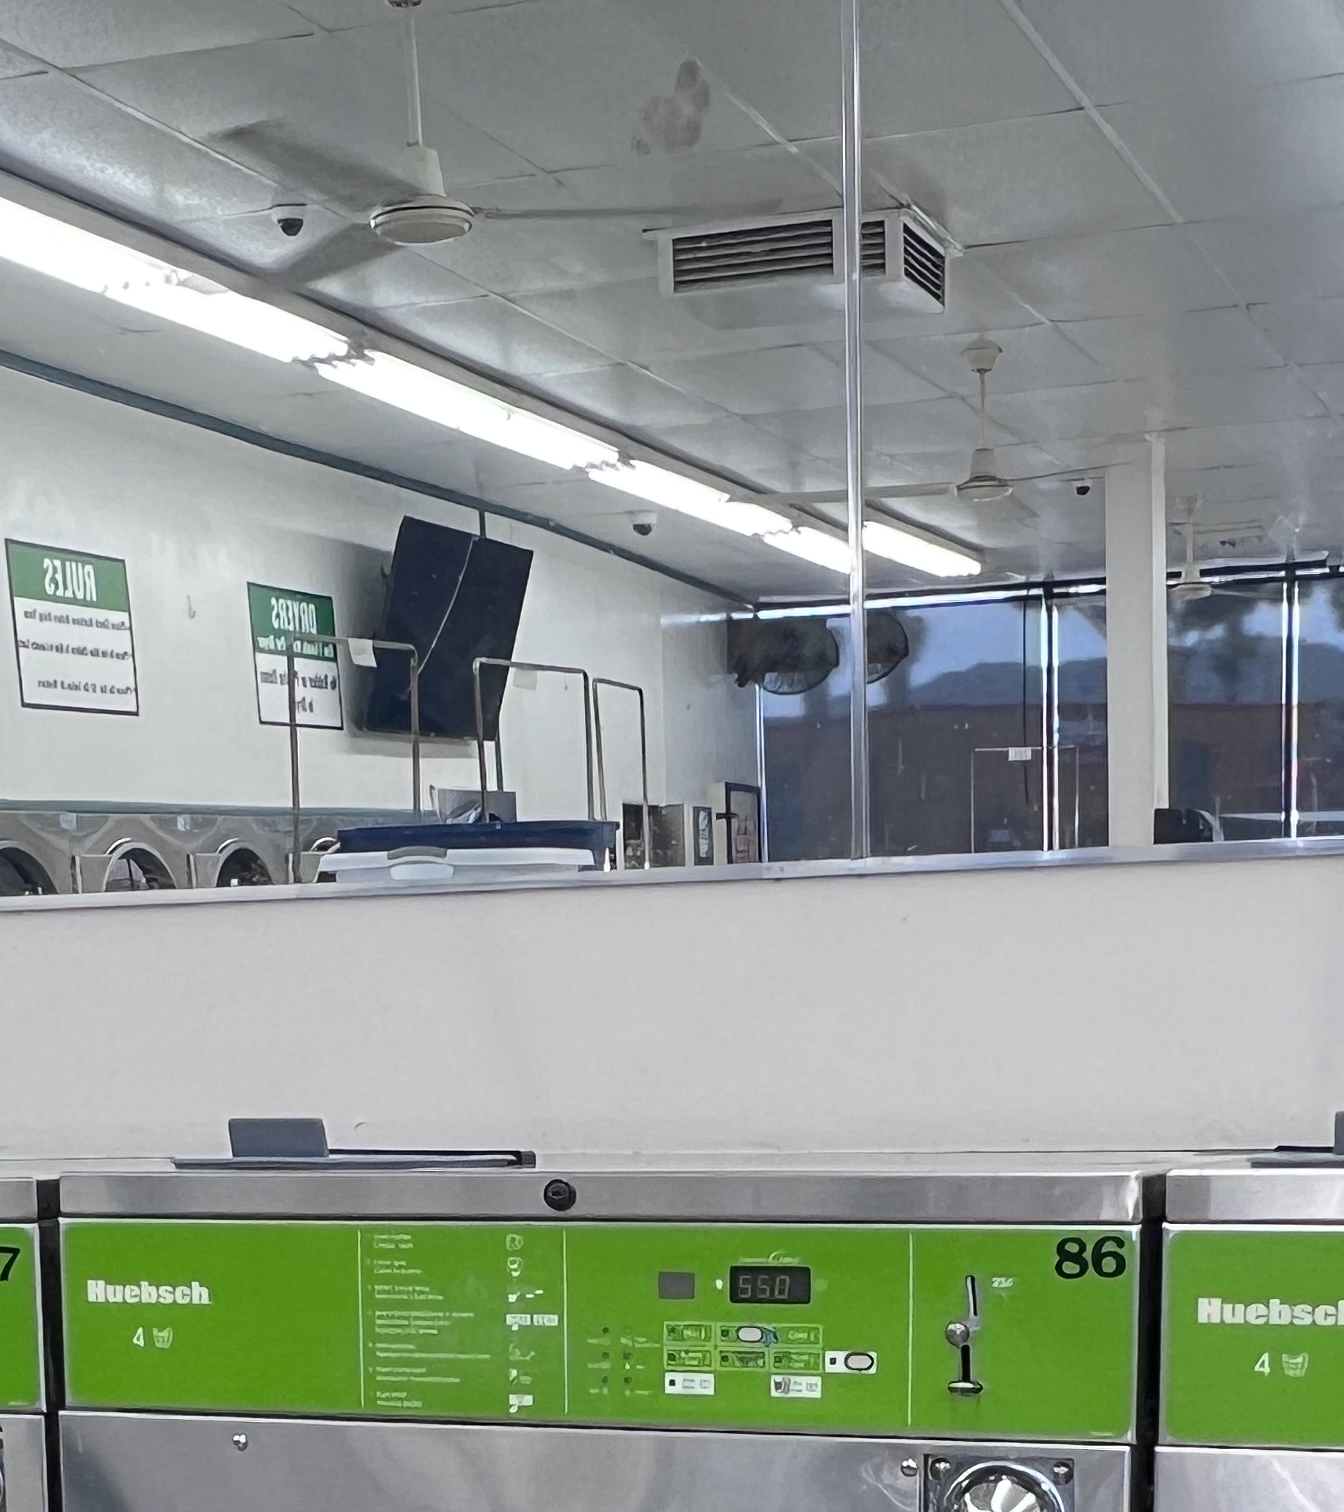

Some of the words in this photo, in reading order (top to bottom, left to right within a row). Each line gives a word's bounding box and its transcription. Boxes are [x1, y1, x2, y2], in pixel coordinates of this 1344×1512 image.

[1054, 1236, 1127, 1280] 86
[87, 1280, 212, 1305] Huebsch
[132, 1327, 144, 1348] 4
[1254, 1351, 1272, 1377] 4
